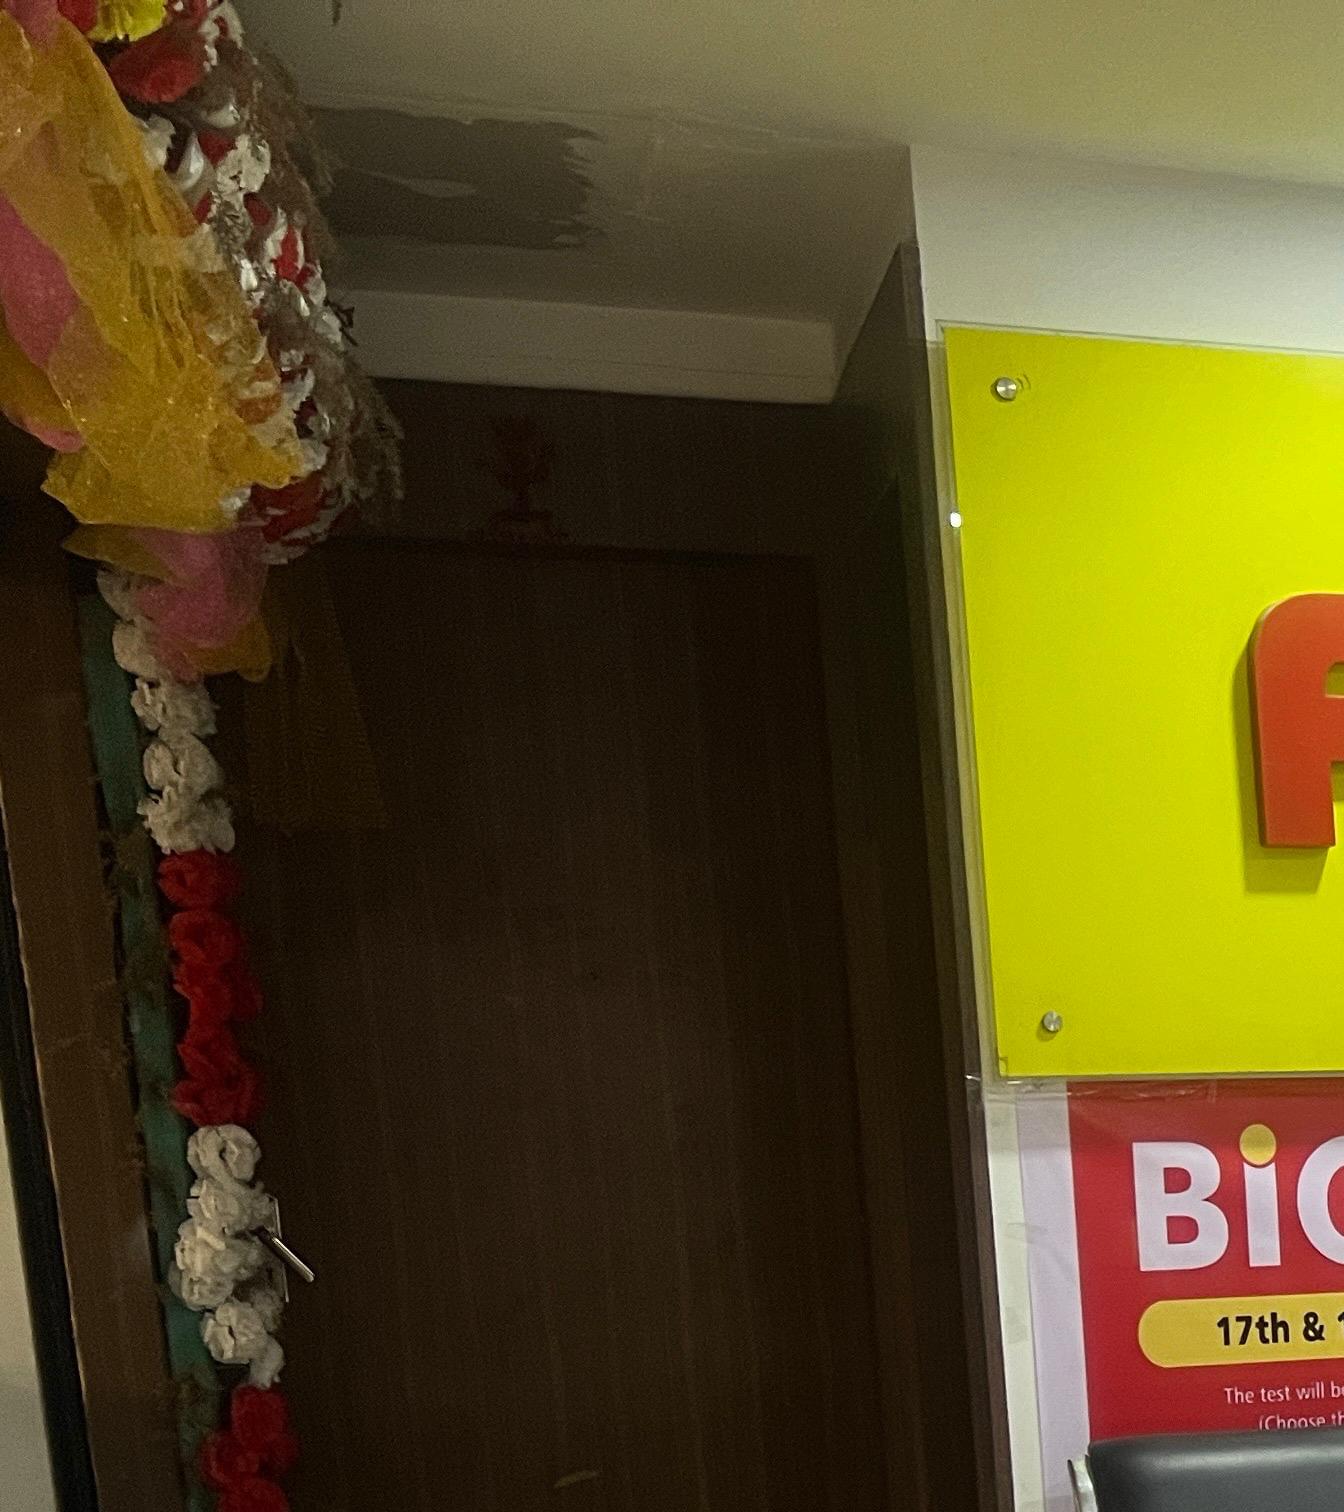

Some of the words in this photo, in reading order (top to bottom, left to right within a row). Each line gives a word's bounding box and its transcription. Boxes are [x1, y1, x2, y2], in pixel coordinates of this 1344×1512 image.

[1217, 1313, 1291, 1346] 17th
[1302, 1312, 1326, 1341] &
[1223, 1387, 1255, 1405] The
[1260, 1385, 1291, 1402] test
[1296, 1382, 1325, 1401] will
